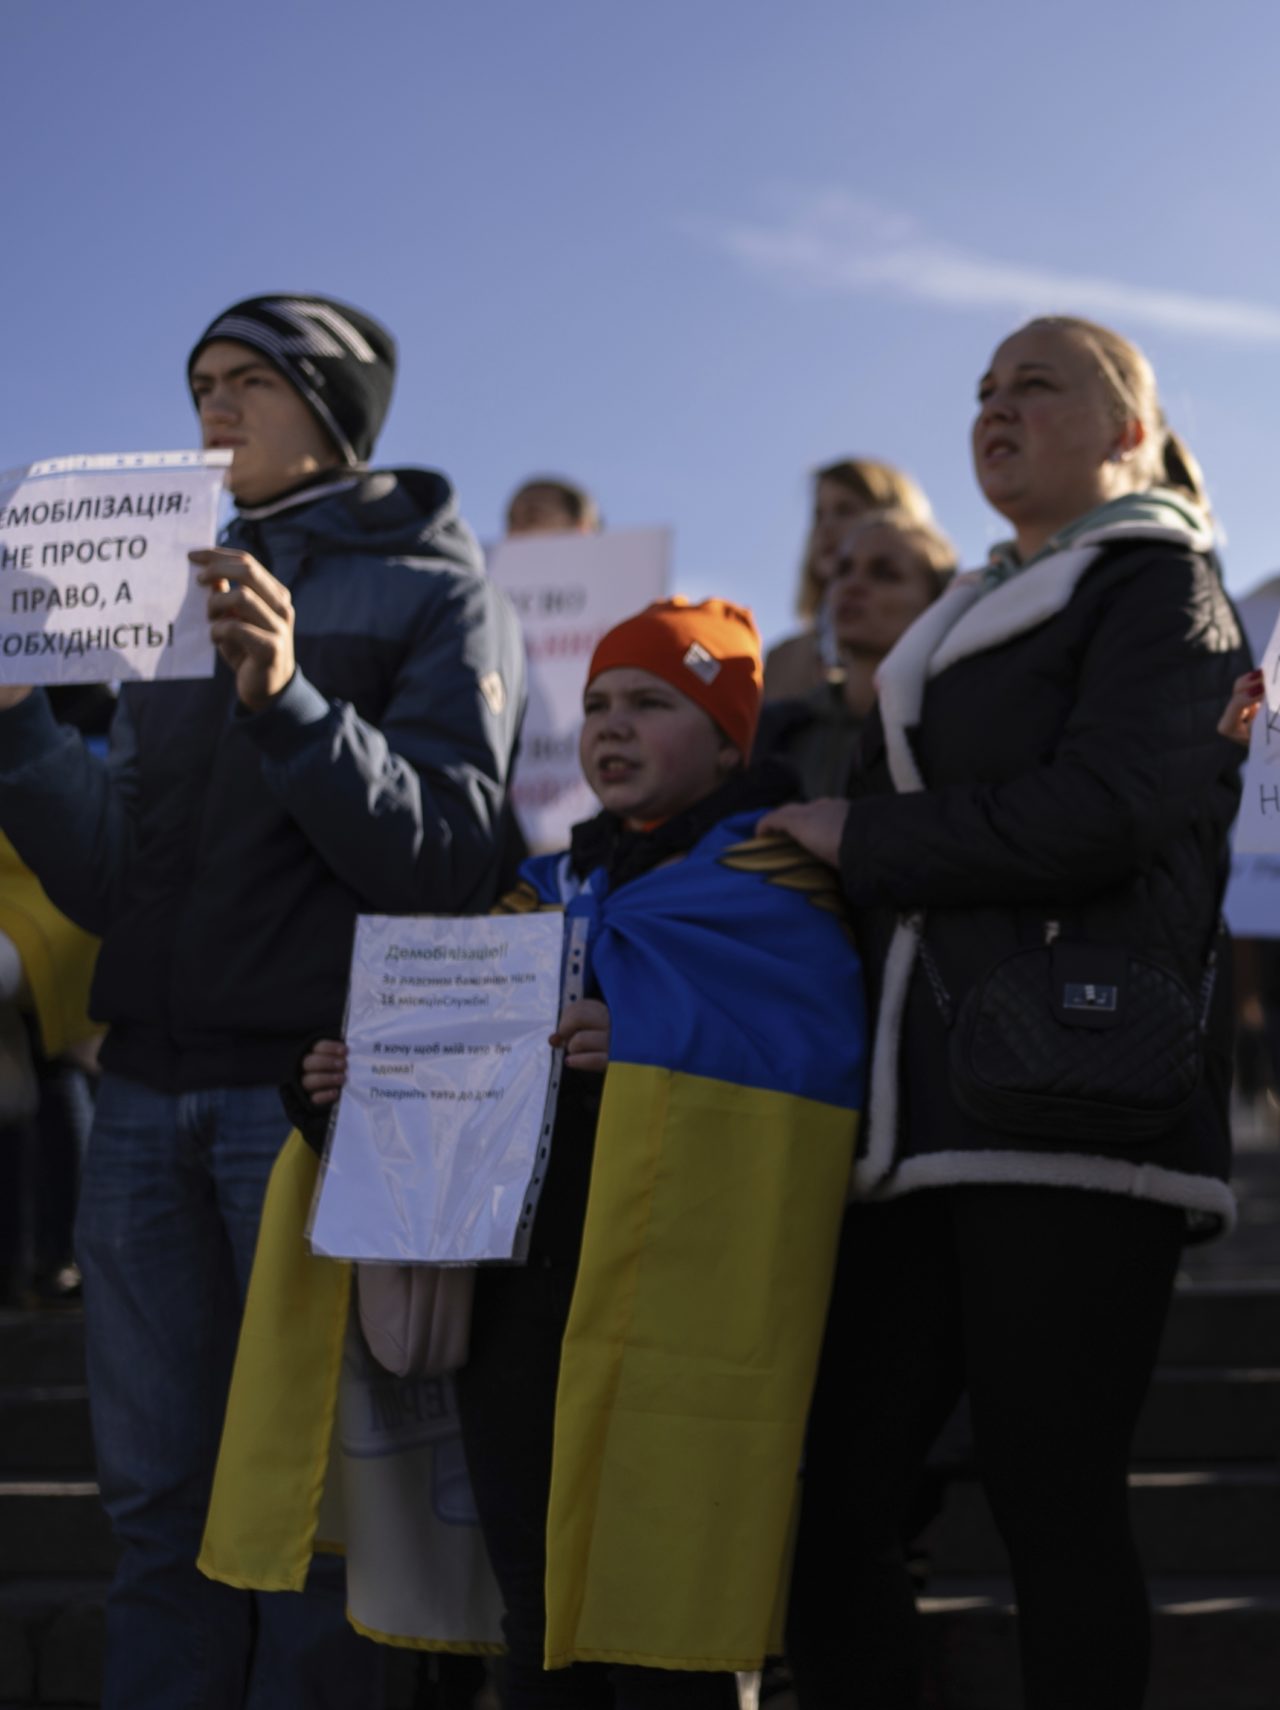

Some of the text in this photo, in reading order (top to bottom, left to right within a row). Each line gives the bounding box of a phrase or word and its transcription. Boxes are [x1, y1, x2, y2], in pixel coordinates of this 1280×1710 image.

[1, 534, 147, 570] НЕ ПРОСТО
[12, 579, 133, 614] ПРАВО, А
[0, 622, 174, 659] ОБХІДНІСТЬ!
